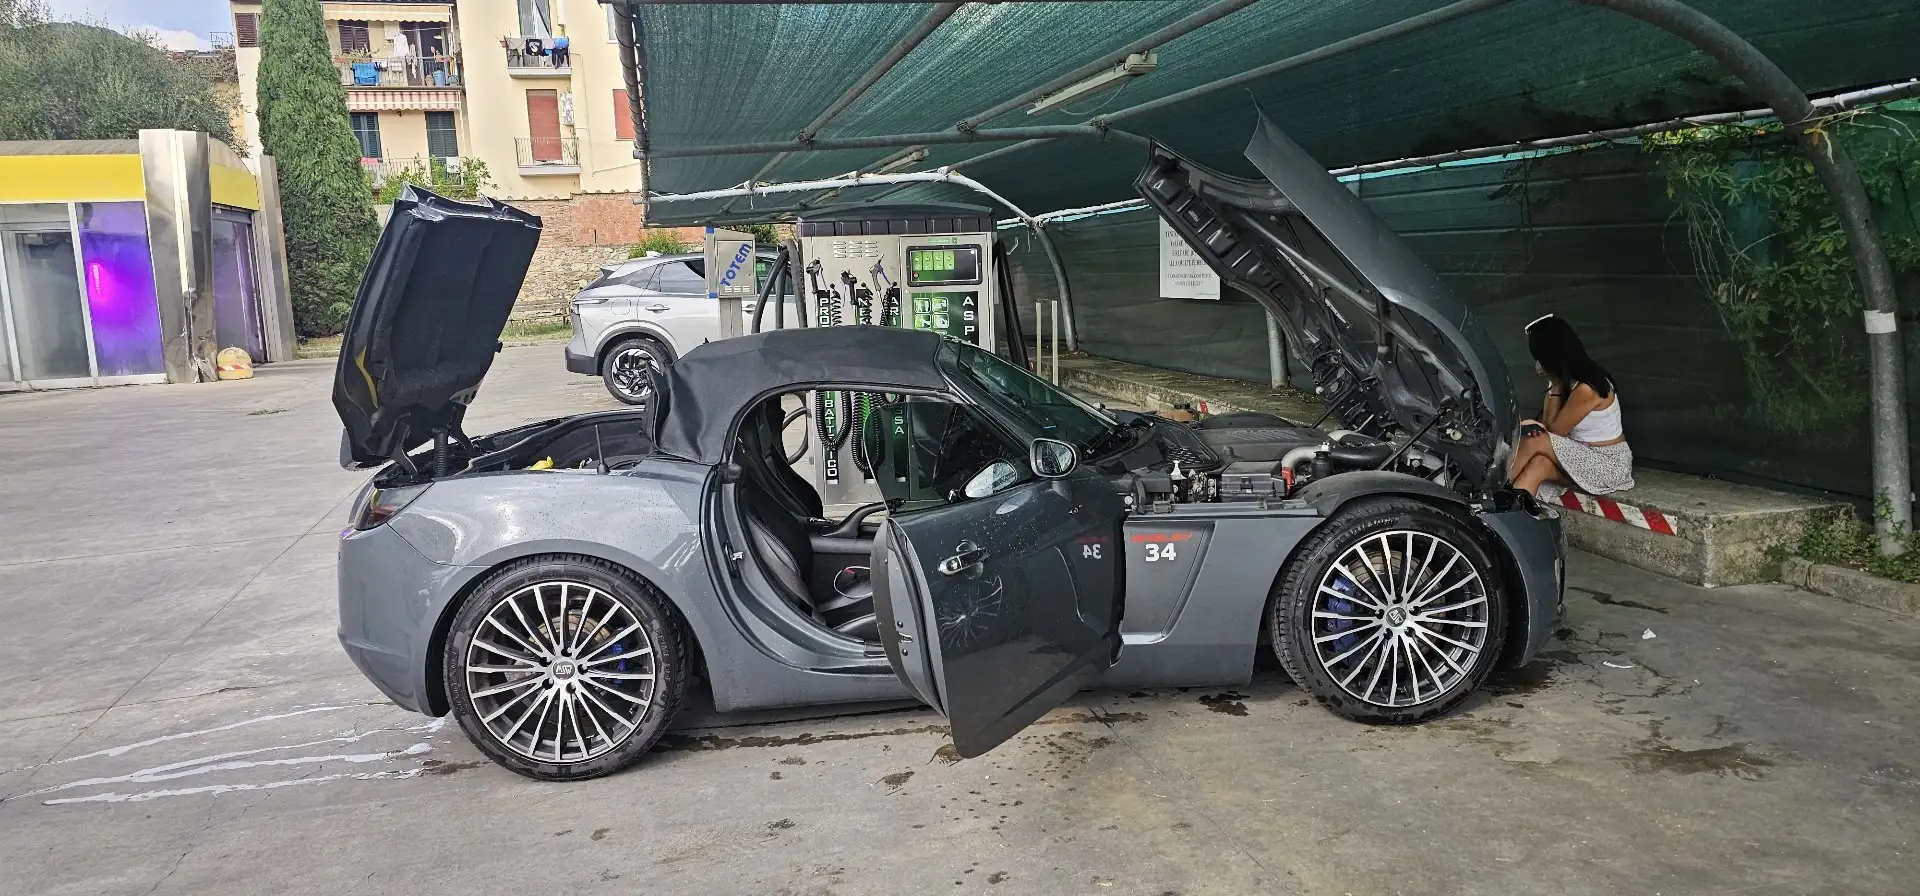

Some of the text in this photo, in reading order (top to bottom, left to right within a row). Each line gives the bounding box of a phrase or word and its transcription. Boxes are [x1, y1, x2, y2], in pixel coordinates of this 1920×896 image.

[962, 295, 976, 344] ASP
[820, 298, 838, 477] PRO IBATTICO
[1145, 542, 1177, 562] 34
